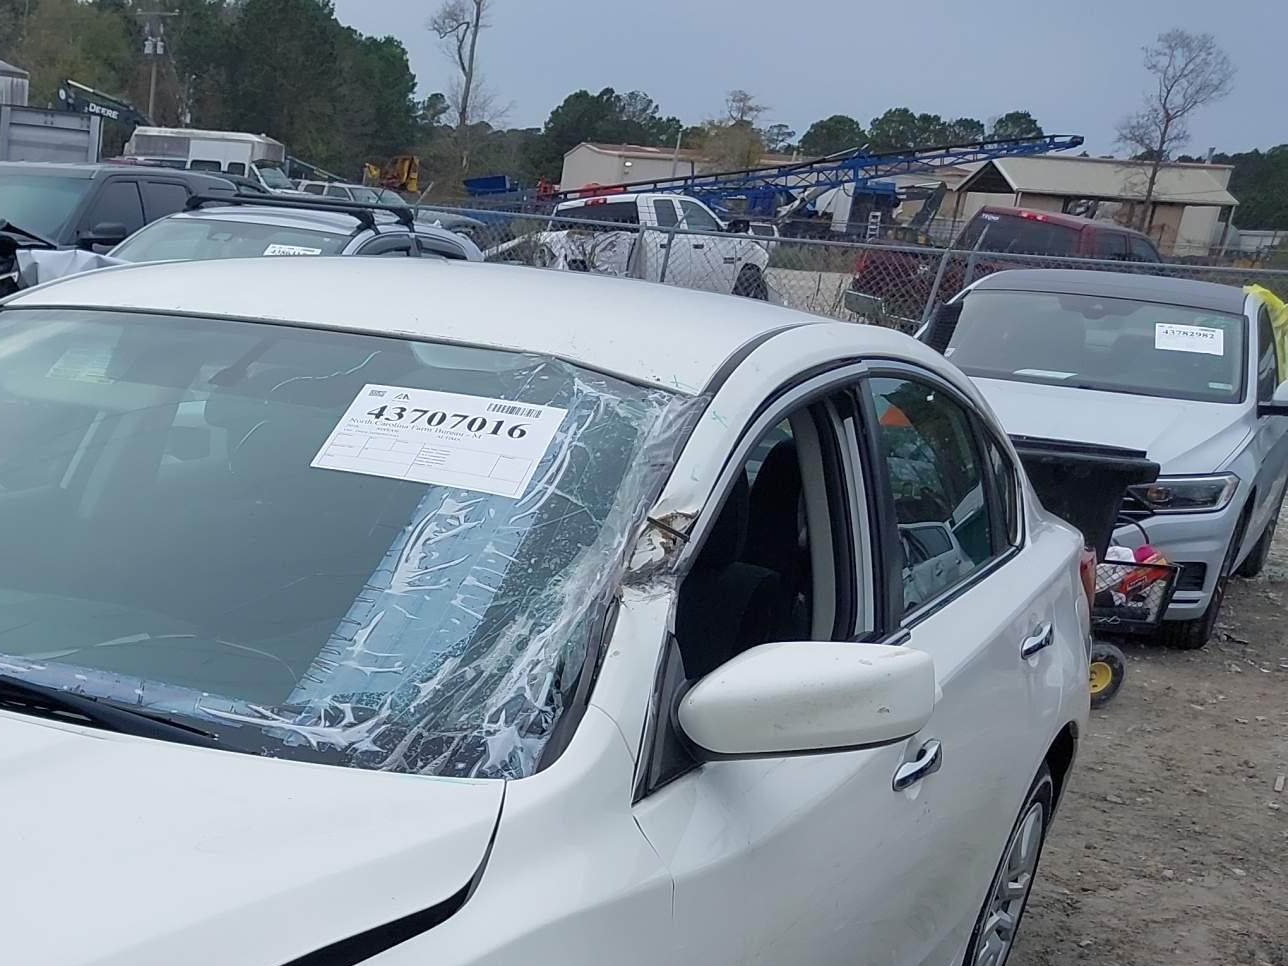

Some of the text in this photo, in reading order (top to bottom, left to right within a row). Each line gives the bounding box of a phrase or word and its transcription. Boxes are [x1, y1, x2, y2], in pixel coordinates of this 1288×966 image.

[89, 103, 119, 119] DEERE
[350, 417, 372, 425] North
[374, 419, 409, 430] Carolina
[410, 424, 433, 433] Farm
[433, 426, 464, 437] Bureau
[367, 404, 532, 439] 43707016
